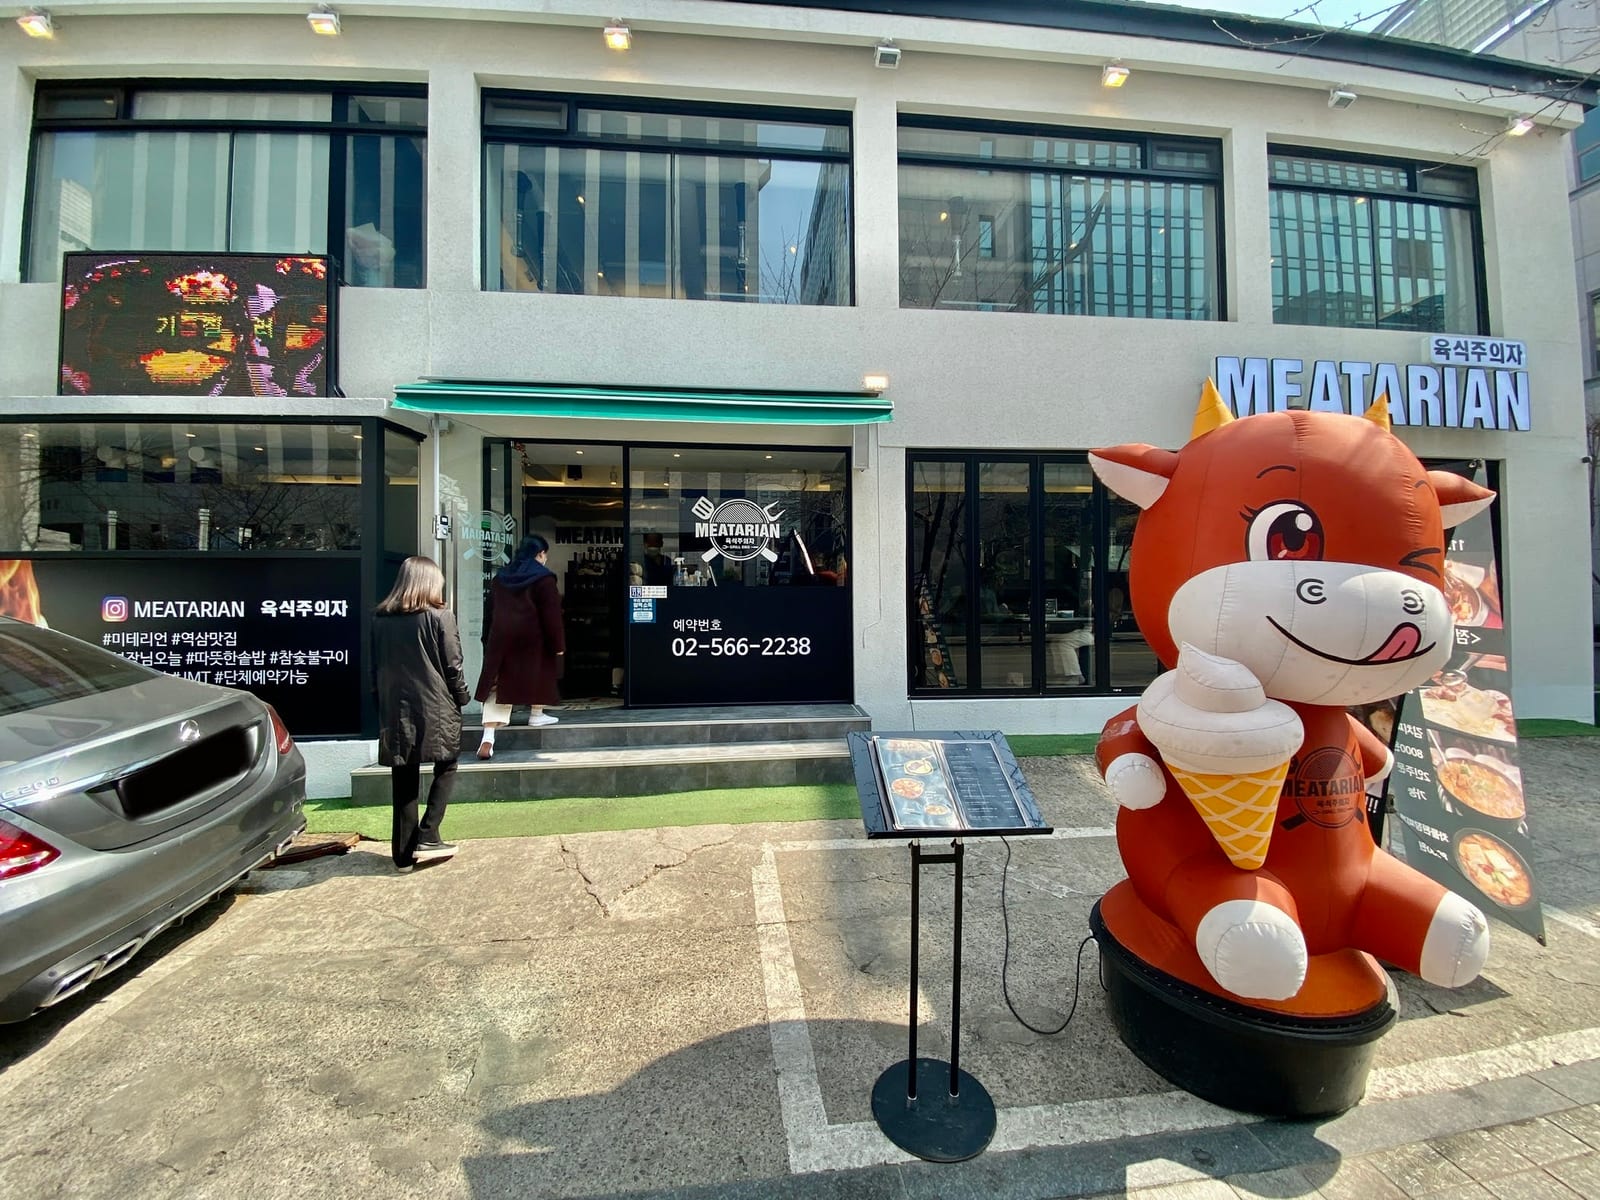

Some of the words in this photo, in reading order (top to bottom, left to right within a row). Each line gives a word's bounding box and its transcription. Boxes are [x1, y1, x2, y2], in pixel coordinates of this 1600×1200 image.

[1433, 337, 1523, 366] 육식주의자
[1215, 356, 1531, 431] MEATARIAN
[695, 522, 780, 539] MEATARIAN
[134, 601, 245, 618] MEATARIAN
[260, 600, 348, 617] 육식주의자
[673, 618, 722, 632] 예약번호
[103, 632, 168, 647] #미테리언
[171, 632, 237, 647] #역삼맛집
[672, 636, 811, 656] 02-566-2238
[186, 650, 266, 666] #따뜻한솥밥
[269, 649, 349, 666] #참숯불구이
[214, 669, 309, 685] #단체예약가능
